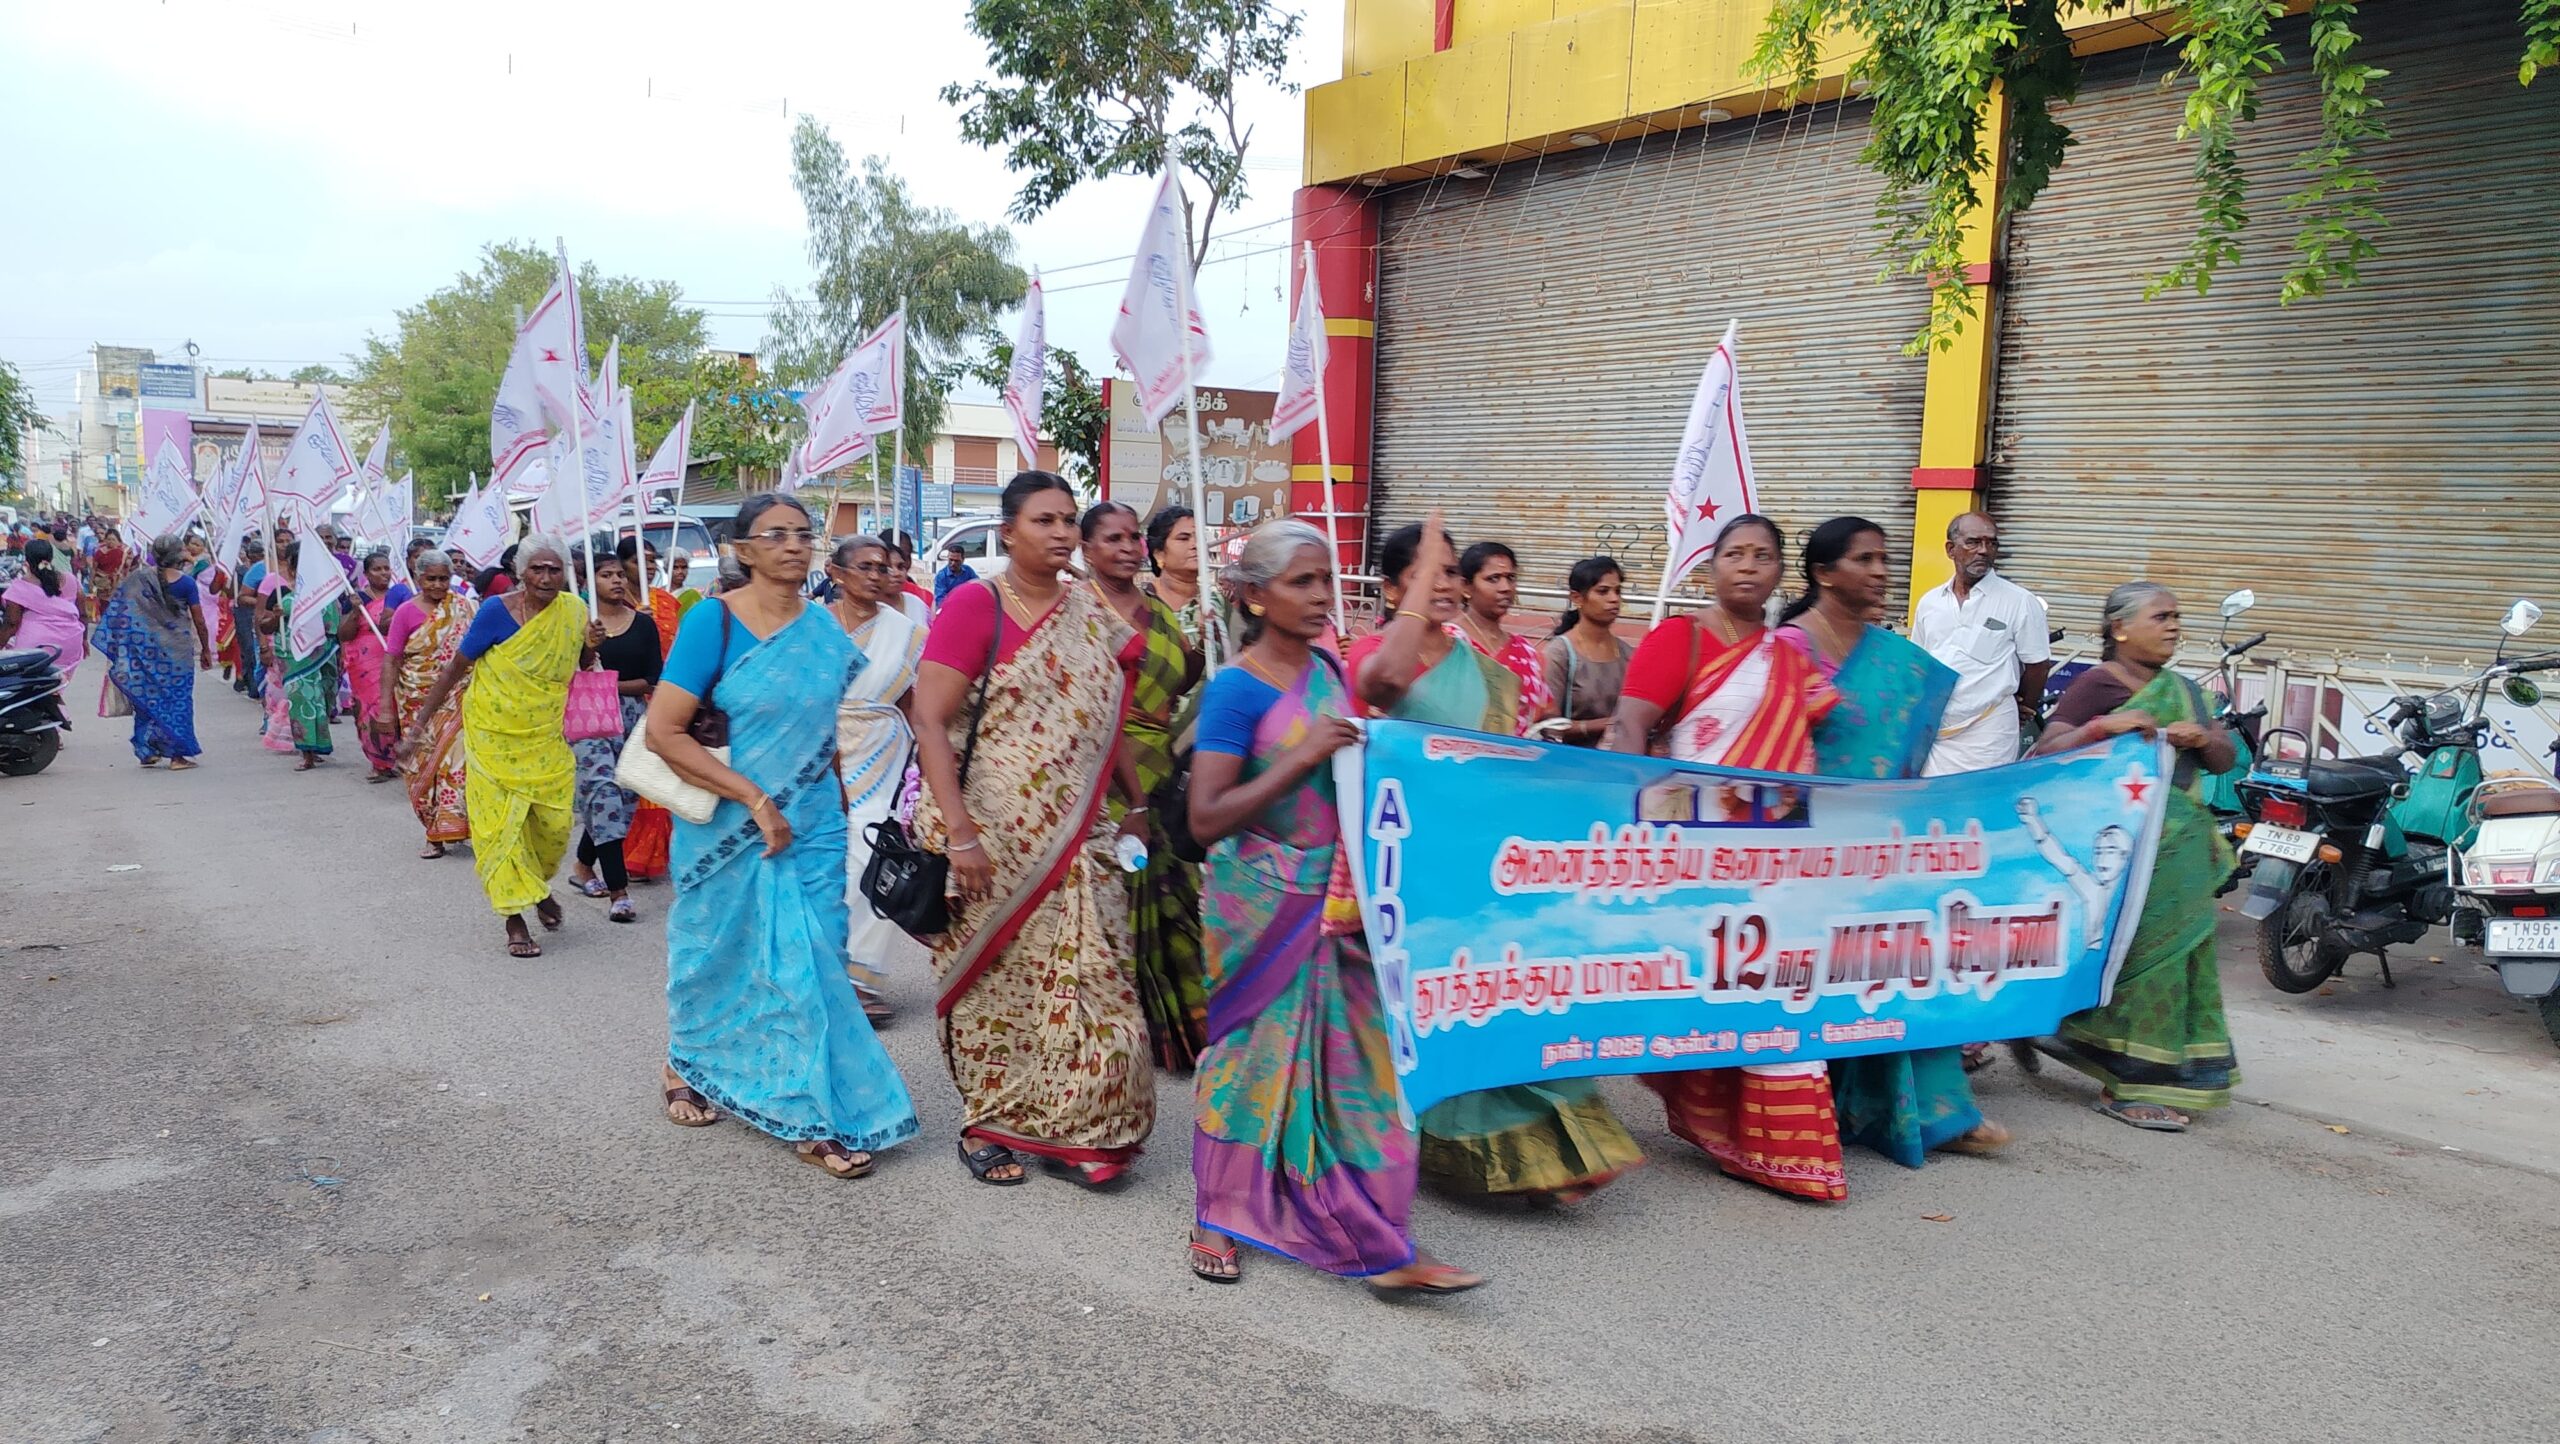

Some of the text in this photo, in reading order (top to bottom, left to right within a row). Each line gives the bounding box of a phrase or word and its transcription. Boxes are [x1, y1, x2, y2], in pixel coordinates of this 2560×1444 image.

[2267, 829, 2283, 840] TN
[2506, 937, 2555, 951] L2244
[1416, 951, 1573, 1028] தூத்துக்குடி
[1582, 954, 1695, 995] மாவட்ட
